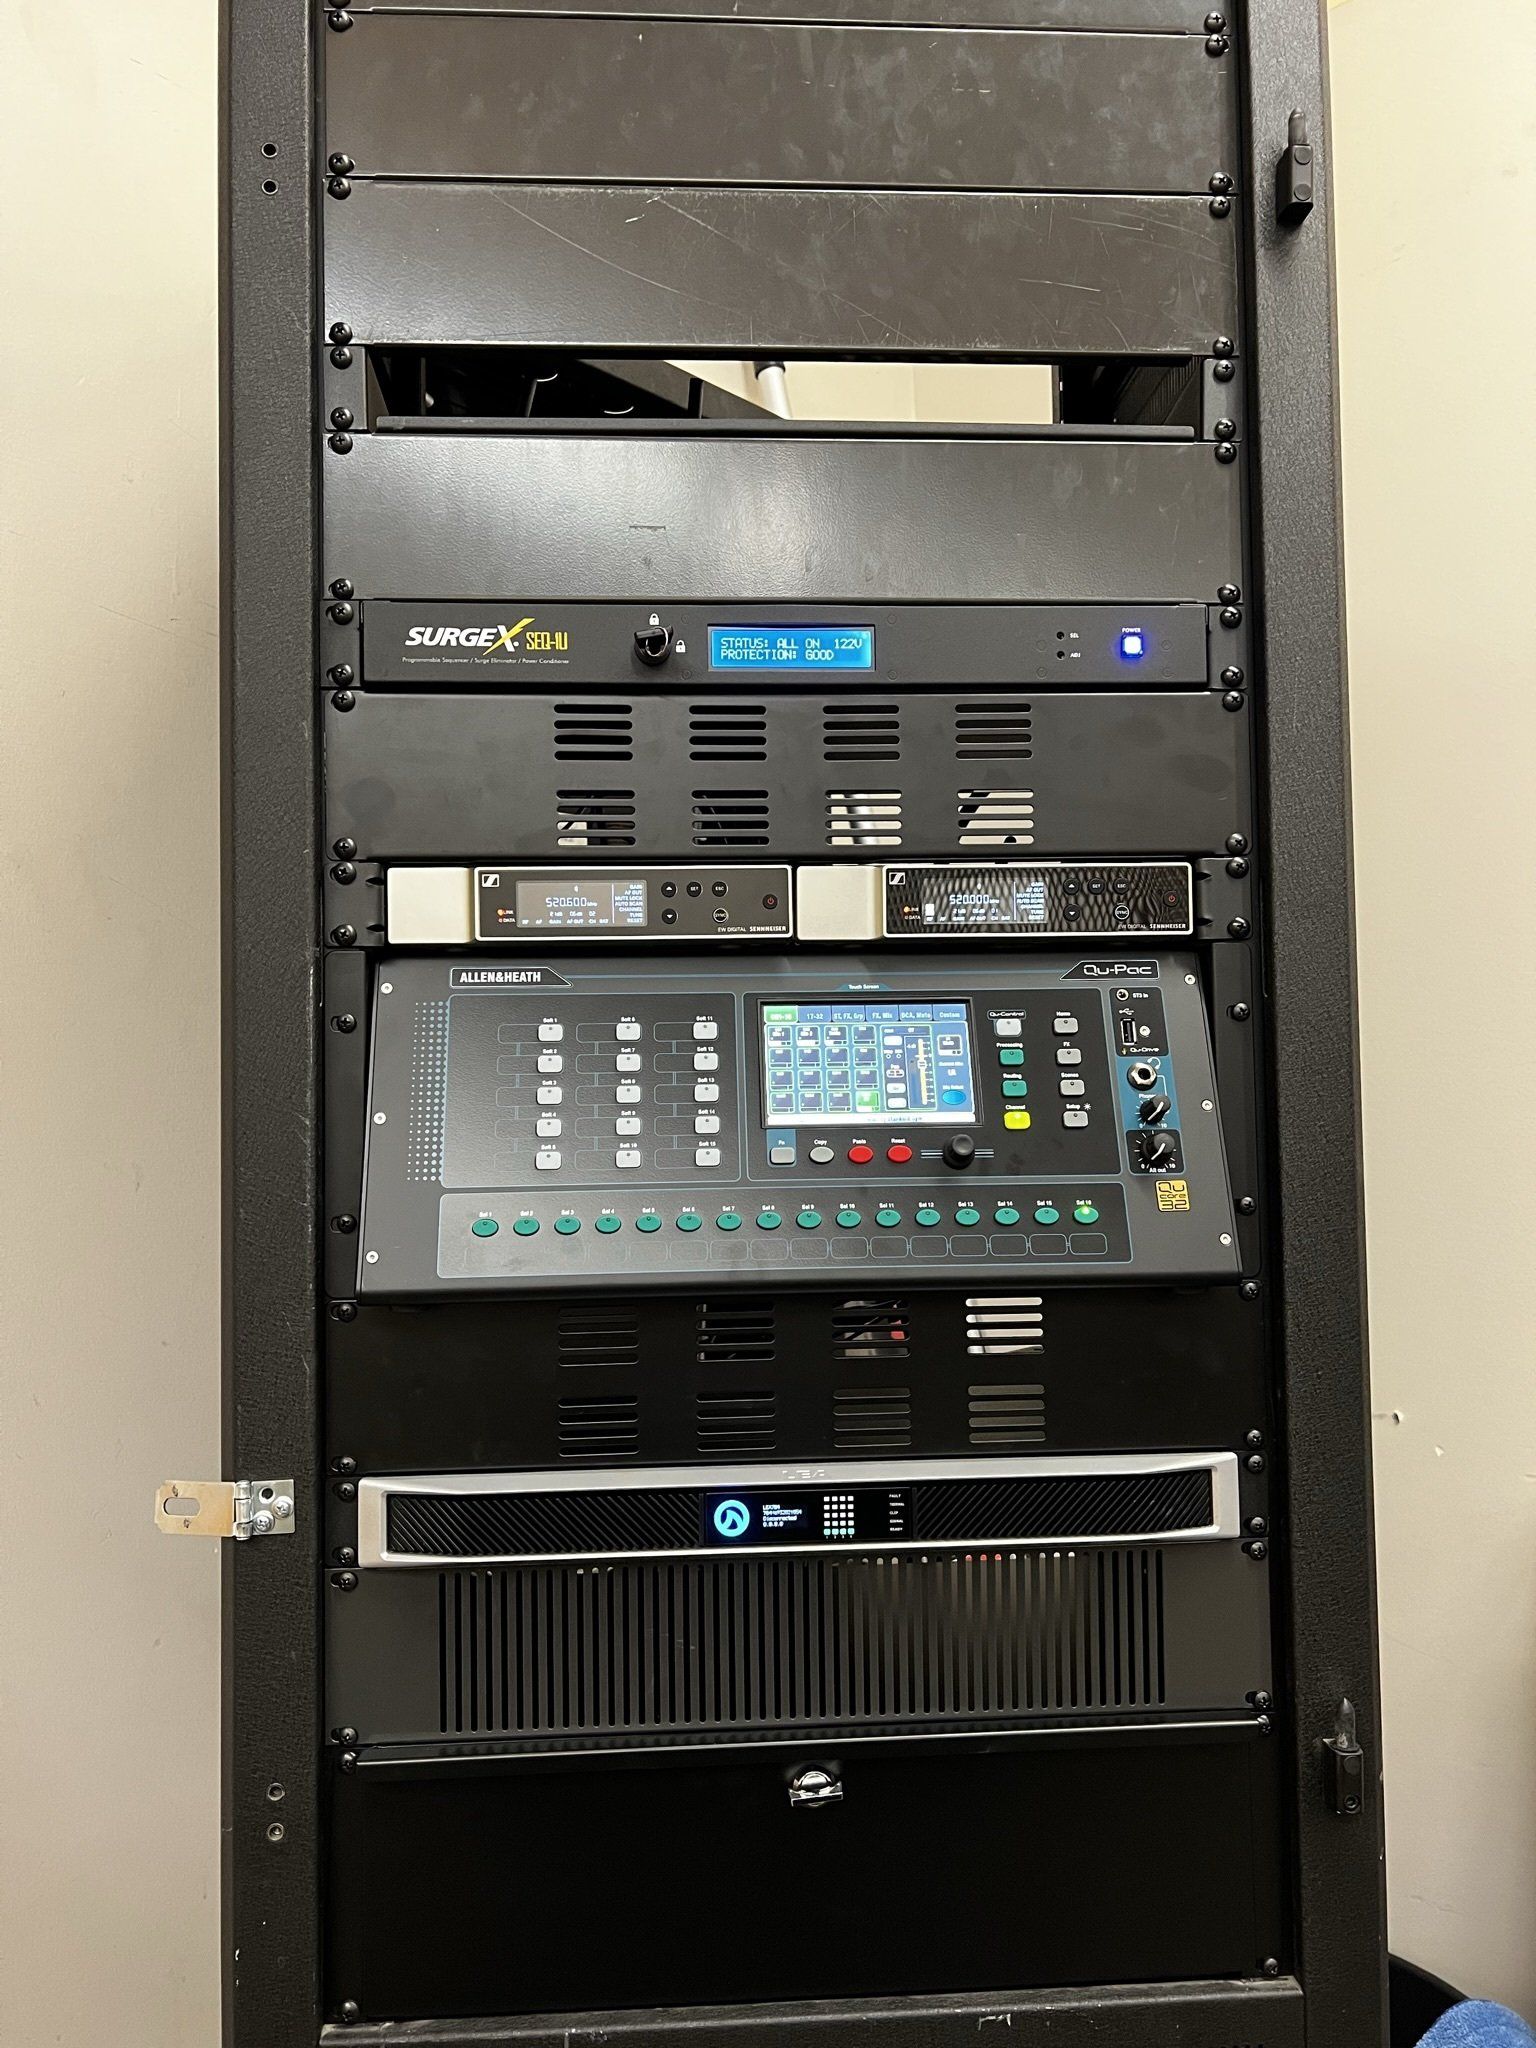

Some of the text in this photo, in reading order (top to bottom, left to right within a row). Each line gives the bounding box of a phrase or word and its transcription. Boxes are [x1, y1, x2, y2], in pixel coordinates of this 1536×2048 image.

[404, 618, 535, 655] SURGEX
[720, 637, 862, 649] STATUS: ALL ON 122V
[720, 649, 834, 661] PROTECTION: GOOD
[1083, 964, 1152, 977] Qu-Pac
[459, 971, 541, 983] ALLEN&HEATH
[1158, 1181, 1185, 1193] Qu
[1160, 1199, 1188, 1210] 32
